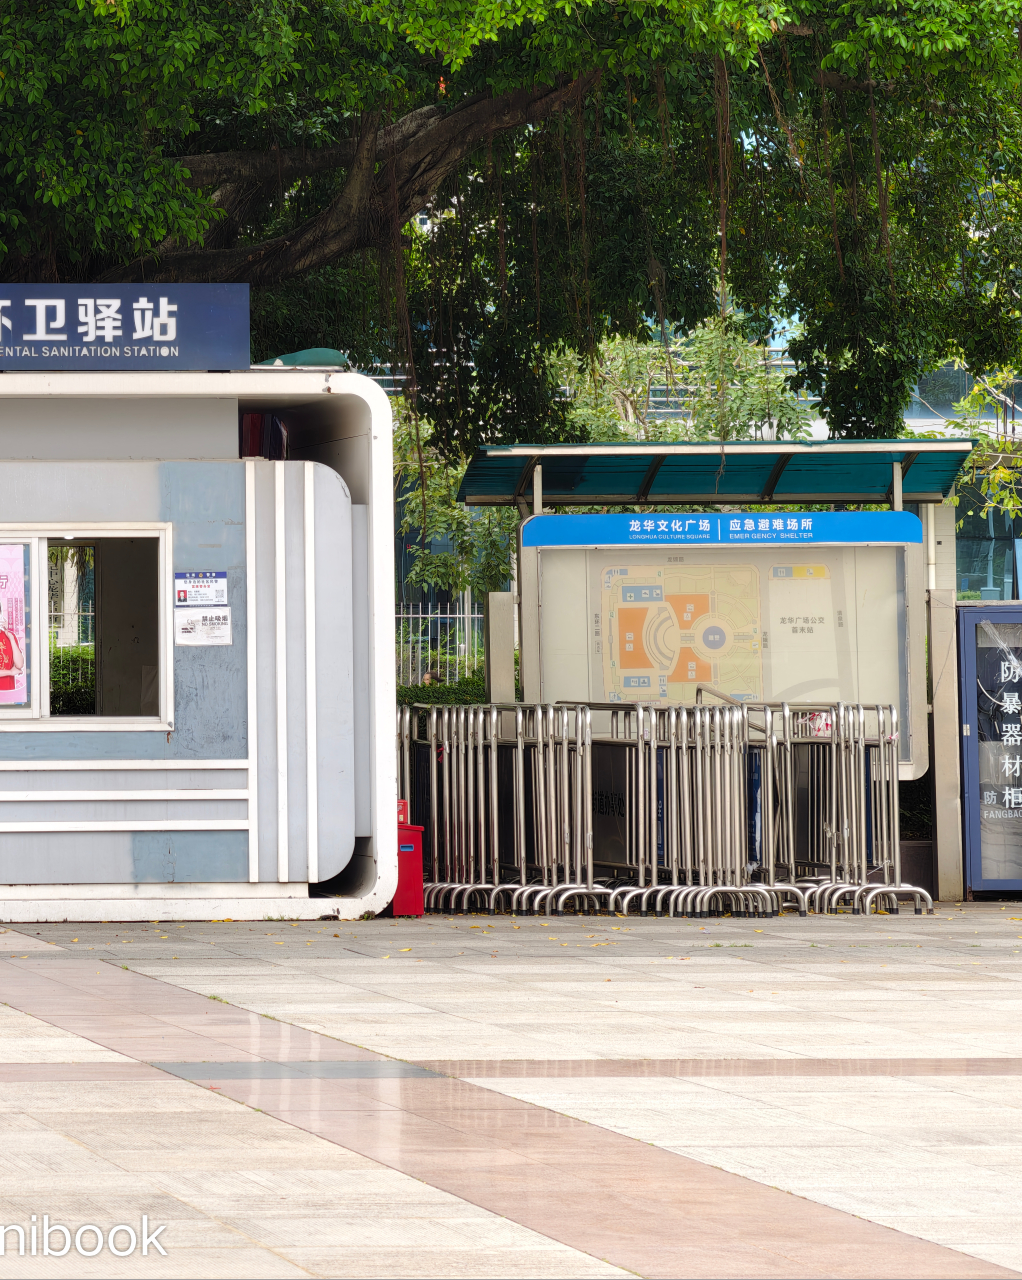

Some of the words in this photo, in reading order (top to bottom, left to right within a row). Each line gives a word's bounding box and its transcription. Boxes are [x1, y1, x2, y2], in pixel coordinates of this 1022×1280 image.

[41, 346, 120, 357] SANITATION
[123, 346, 179, 357] STATION
[629, 519, 710, 532] 龙华文化广场
[729, 518, 813, 531] 应急避难场所
[779, 616, 825, 625] 龙华广场公交
[1000, 661, 1022, 809] 防暴器材柜
[983, 791, 998, 805] 防
